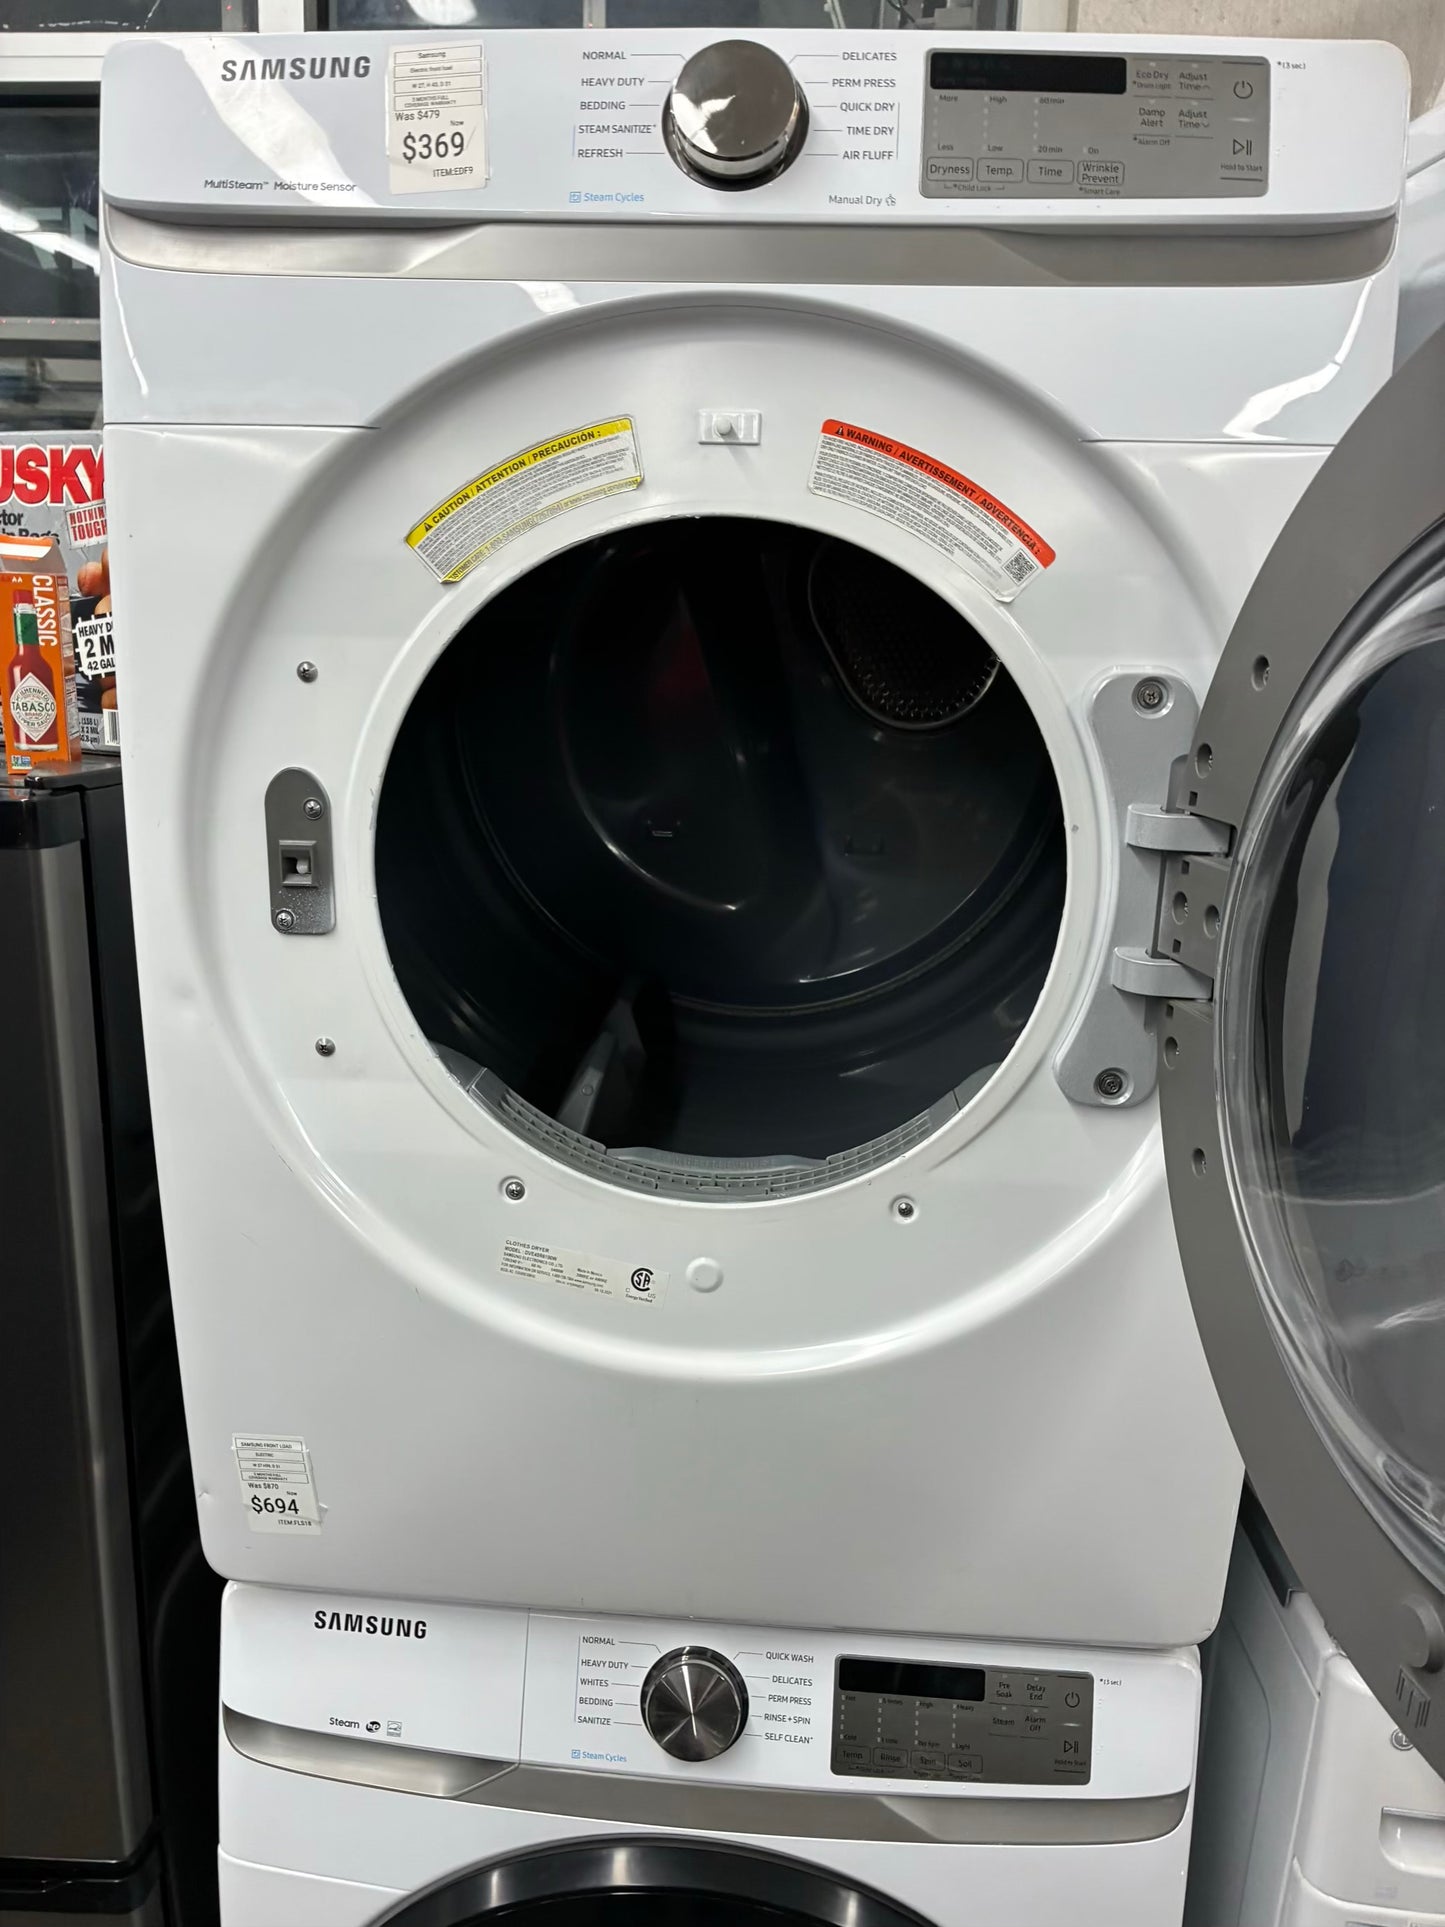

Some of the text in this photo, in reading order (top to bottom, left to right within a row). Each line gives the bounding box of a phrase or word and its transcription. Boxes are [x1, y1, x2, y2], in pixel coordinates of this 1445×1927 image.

[583, 51, 626, 60] NORMAL
[842, 52, 897, 61] DELICATES
[221, 56, 371, 82] SAMSUNG
[1136, 71, 1168, 80] Eco Dry
[1179, 72, 1207, 81] Adjust
[581, 78, 645, 86] HEAVY DUTY
[832, 79, 896, 88] PERM PRESS
[1179, 82, 1201, 90] Time
[989, 96, 1007, 104] High
[580, 101, 626, 110] BEDDING
[840, 102, 895, 111] QUICK DRY
[395, 110, 440, 121] Was $479
[1138, 108, 1165, 117] Damp
[1178, 110, 1207, 119] Adjust
[1140, 118, 1163, 127] Alert
[1178, 120, 1201, 128] Time
[579, 125, 610, 133] STEAM
[847, 126, 894, 135] TIME DRY
[402, 131, 464, 164] $369
[578, 149, 623, 158] REFRESH
[842, 151, 894, 160] AIR FLUFF
[930, 164, 970, 176] Dryness
[986, 165, 1014, 176] Temp.
[1038, 166, 1063, 177] Time
[1082, 163, 1119, 173] Wrinkle
[1220, 163, 1236, 171] Hold
[1081, 173, 1119, 183] Prevent
[274, 181, 357, 191] Moisture Sensor
[584, 193, 644, 203] Steam Cycles
[829, 195, 882, 206] Manual Dry
[432, 492, 470, 524] CAUTION
[475, 458, 526, 493] ATTENTION
[846, 428, 893, 453] WARNING
[899, 451, 976, 497] AVERTISSEMENT
[980, 498, 1037, 551] ADVERTENCIA
[32, 575, 57, 646] CLASSIC
[78, 622, 103, 637] HEAVY
[84, 634, 114, 658] 2 M
[88, 661, 99, 671] 42
[12, 701, 56, 712] TABASCO
[506, 1240, 549, 1253] CLOTHES DRYER
[251, 1494, 299, 1514] $694
[314, 1610, 427, 1639] SAMSUNG
[582, 1636, 615, 1645] NORMAL
[766, 1651, 814, 1663] QUICK WASH
[581, 1659, 628, 1669] HEAVY DUTY
[580, 1678, 609, 1687] WHITES
[772, 1675, 813, 1686] DELICATES
[1026, 1683, 1046, 1693] Delay
[996, 1690, 1012, 1698] Soak
[1029, 1692, 1043, 1700] End
[579, 1697, 613, 1706] BEDDING
[768, 1694, 812, 1705] PERM PRESS
[329, 1717, 360, 1728] Steam
[578, 1715, 611, 1725] SANITIZE
[764, 1713, 787, 1722] RINSE
[793, 1716, 811, 1724] SPIN
[992, 1717, 1015, 1725] Steam
[1025, 1715, 1046, 1723] Alarm
[1029, 1724, 1041, 1732] Off
[765, 1732, 783, 1741] SELF
[582, 1751, 627, 1763] Steam Cycles
[880, 1753, 901, 1762] Rinse
[920, 1756, 936, 1765] Spin
[958, 1758, 972, 1767] Soil
